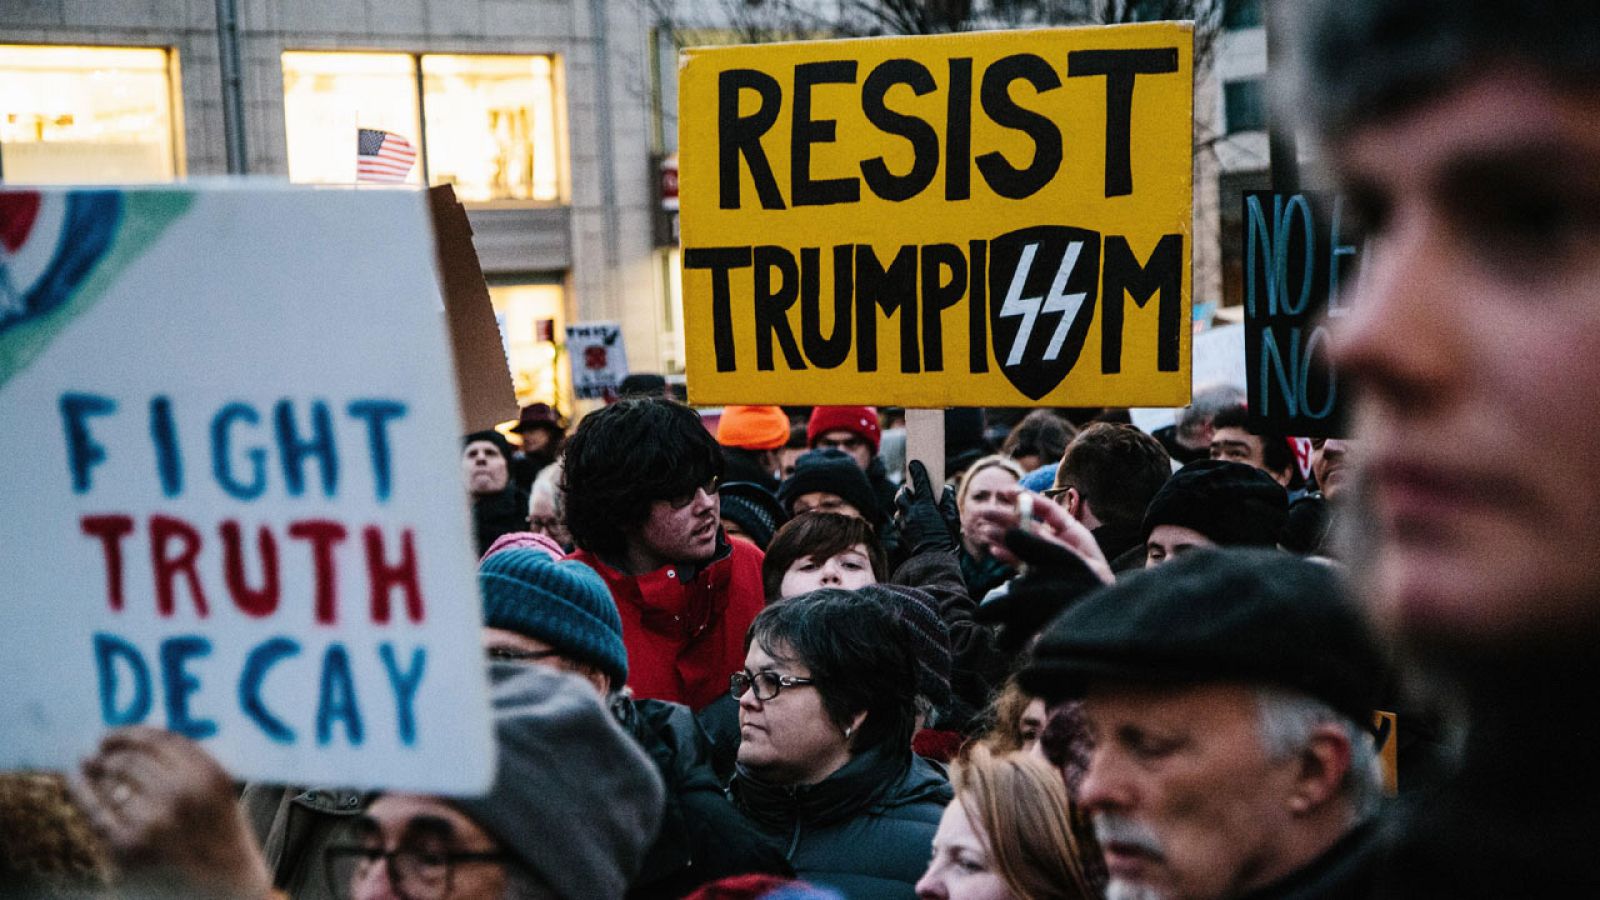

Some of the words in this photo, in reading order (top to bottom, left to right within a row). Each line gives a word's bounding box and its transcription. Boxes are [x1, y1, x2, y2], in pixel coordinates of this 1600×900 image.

[718, 48, 1179, 210] RESIST
[1247, 194, 1316, 318] NO
[1260, 325, 1336, 420] NO
[60, 392, 407, 499] FIGHT
[80, 515, 425, 625] TRUTH
[94, 632, 426, 747] DECAY
